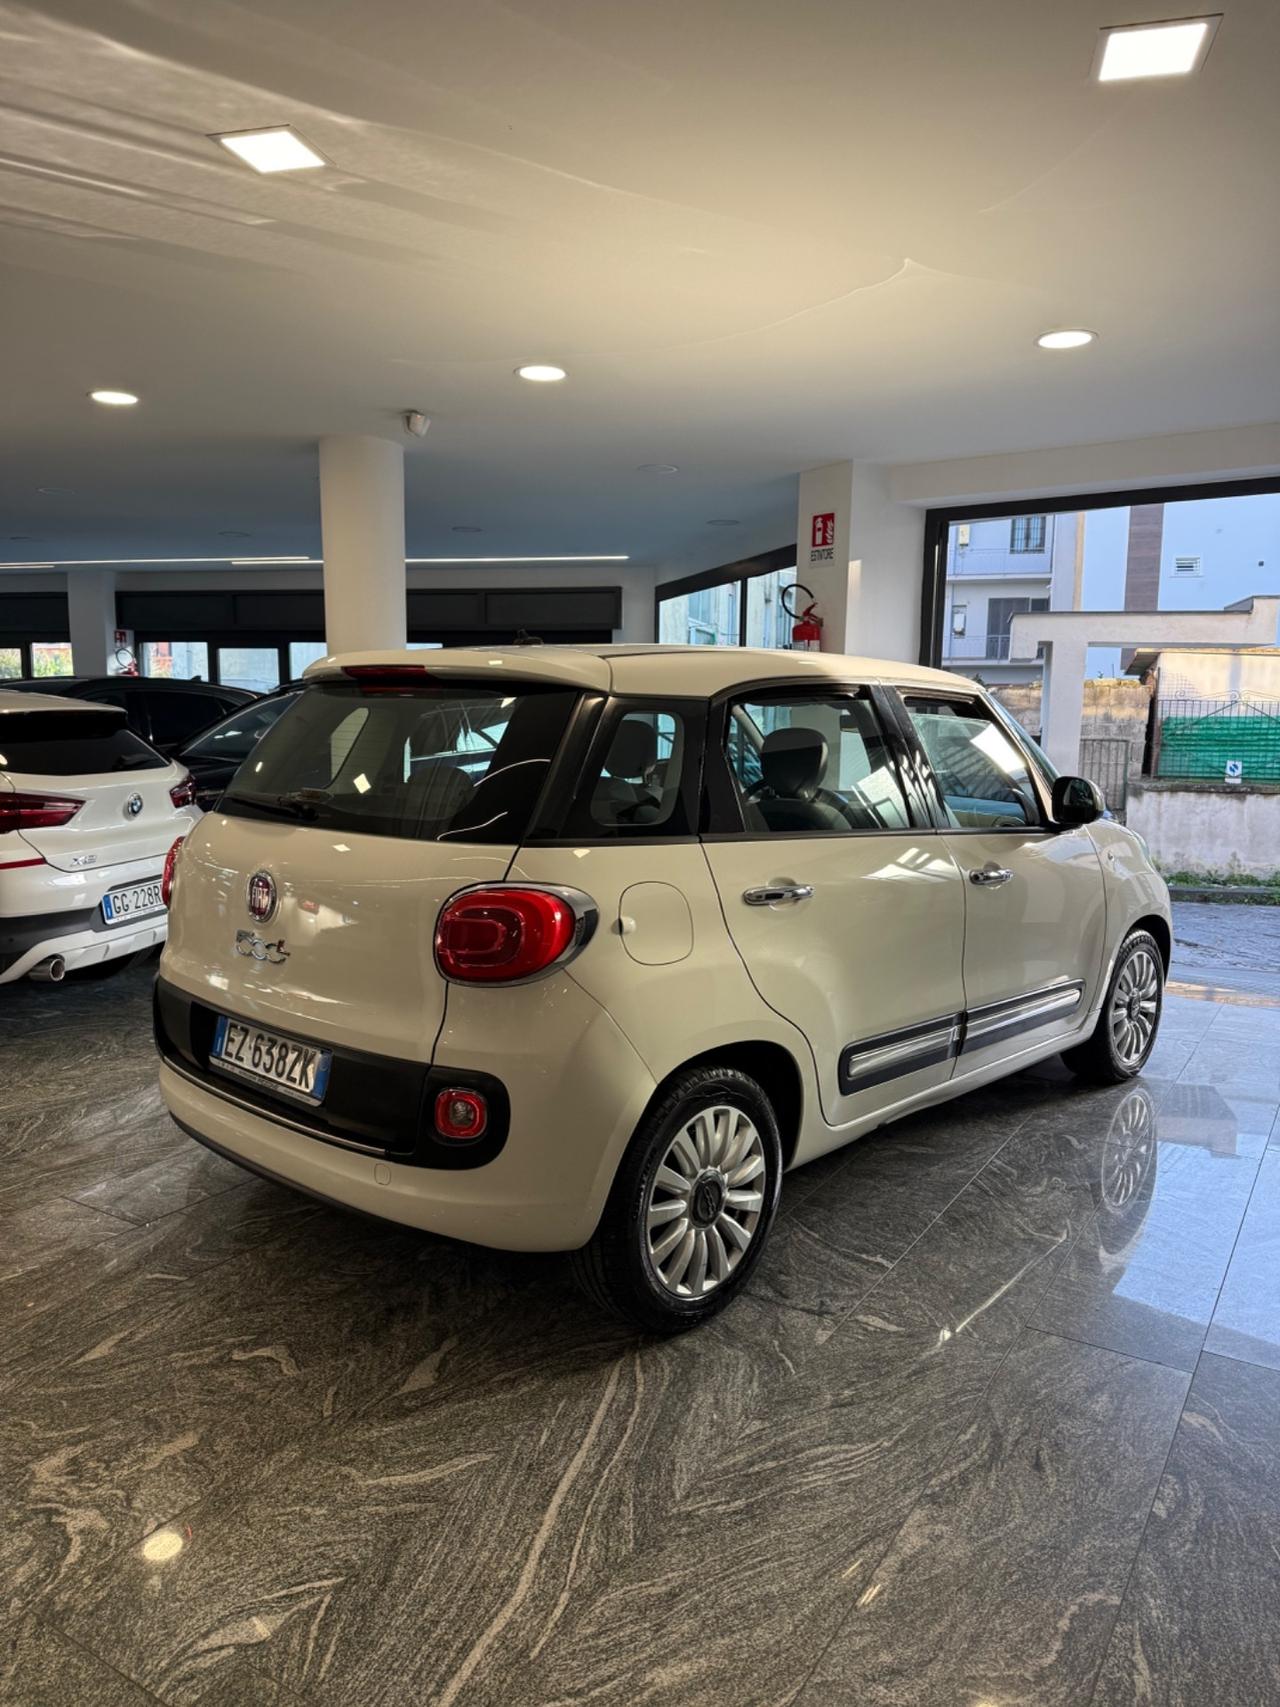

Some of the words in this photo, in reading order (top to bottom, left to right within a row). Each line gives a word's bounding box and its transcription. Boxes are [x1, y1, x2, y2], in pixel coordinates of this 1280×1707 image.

[811, 547, 834, 561] ESTINTORE
[112, 893, 130, 915] GG
[132, 884, 163, 910] 228R
[252, 886, 269, 909] FIAT
[224, 1022, 250, 1063] EZ
[251, 1033, 317, 1090] 638ZK
